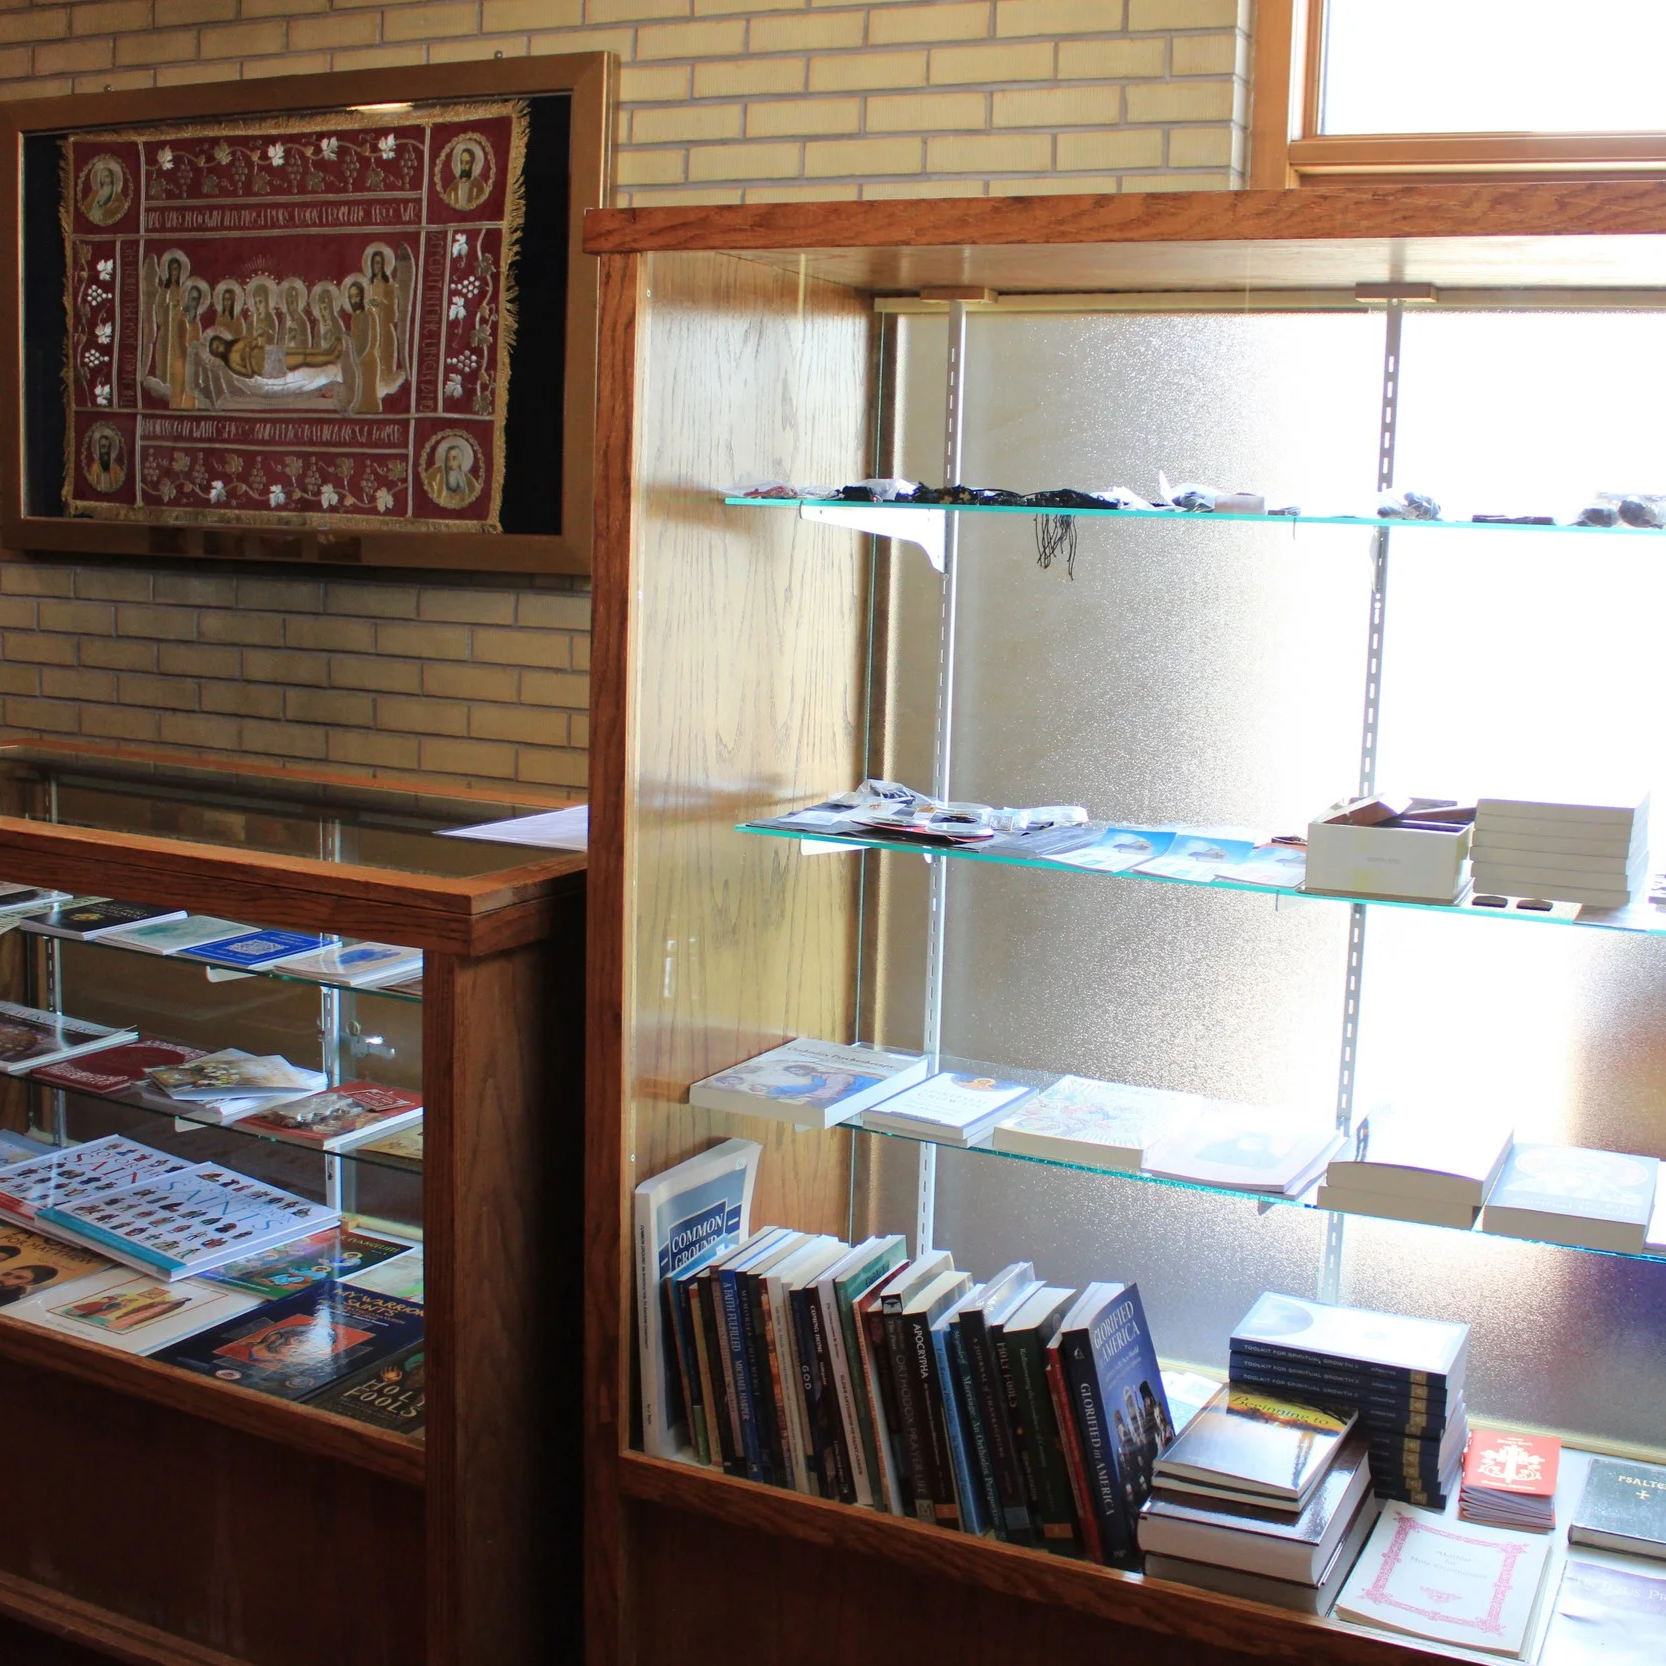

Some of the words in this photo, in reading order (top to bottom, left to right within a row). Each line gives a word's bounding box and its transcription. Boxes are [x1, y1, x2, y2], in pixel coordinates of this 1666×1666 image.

[671, 1213, 724, 1253] COMMON
[347, 1298, 399, 1317] SAINTS
[722, 1288, 735, 1312] FAITH
[725, 1312, 741, 1352] FULFILLED
[809, 1304, 820, 1332] COMING
[1093, 1300, 1134, 1349] GLORIFIED
[814, 1332, 823, 1353] HOME
[911, 1322, 930, 1380] APOCRYPHA
[996, 1341, 1010, 1369] HOLY
[1101, 1320, 1140, 1364] AMERICA
[1244, 1344, 1271, 1354] TOOLKIT
[1288, 1352, 1322, 1365] SPIRITUAL
[1323, 1359, 1354, 1369] GROWTH
[732, 1359, 747, 1391] MICHAEL
[801, 1365, 812, 1391] GOD
[1243, 1373, 1271, 1383] TOOLKIT
[1272, 1378, 1286, 1386] FOR
[1286, 1381, 1320, 1392] SPIRITUAL
[1322, 1387, 1353, 1397] GROWTH
[1244, 1360, 1272, 1369] TOOLKIT
[1288, 1368, 1322, 1378] SPIRITUAL
[1323, 1374, 1355, 1383] GROWTH
[342, 1386, 417, 1418] FOOLS
[894, 1354, 916, 1424] ORTHODOX
[737, 1392, 751, 1420] HARPER
[1079, 1382, 1102, 1448] GLORIFIED
[1232, 1395, 1310, 1424] Beginning
[1313, 1416, 1329, 1425] to
[971, 1420, 982, 1433] An
[906, 1427, 923, 1471] PRAYER
[973, 1433, 992, 1475] Orthodox
[1092, 1448, 1103, 1459] in
[914, 1473, 927, 1495] LIFE
[1094, 1459, 1116, 1515] AMERICA
